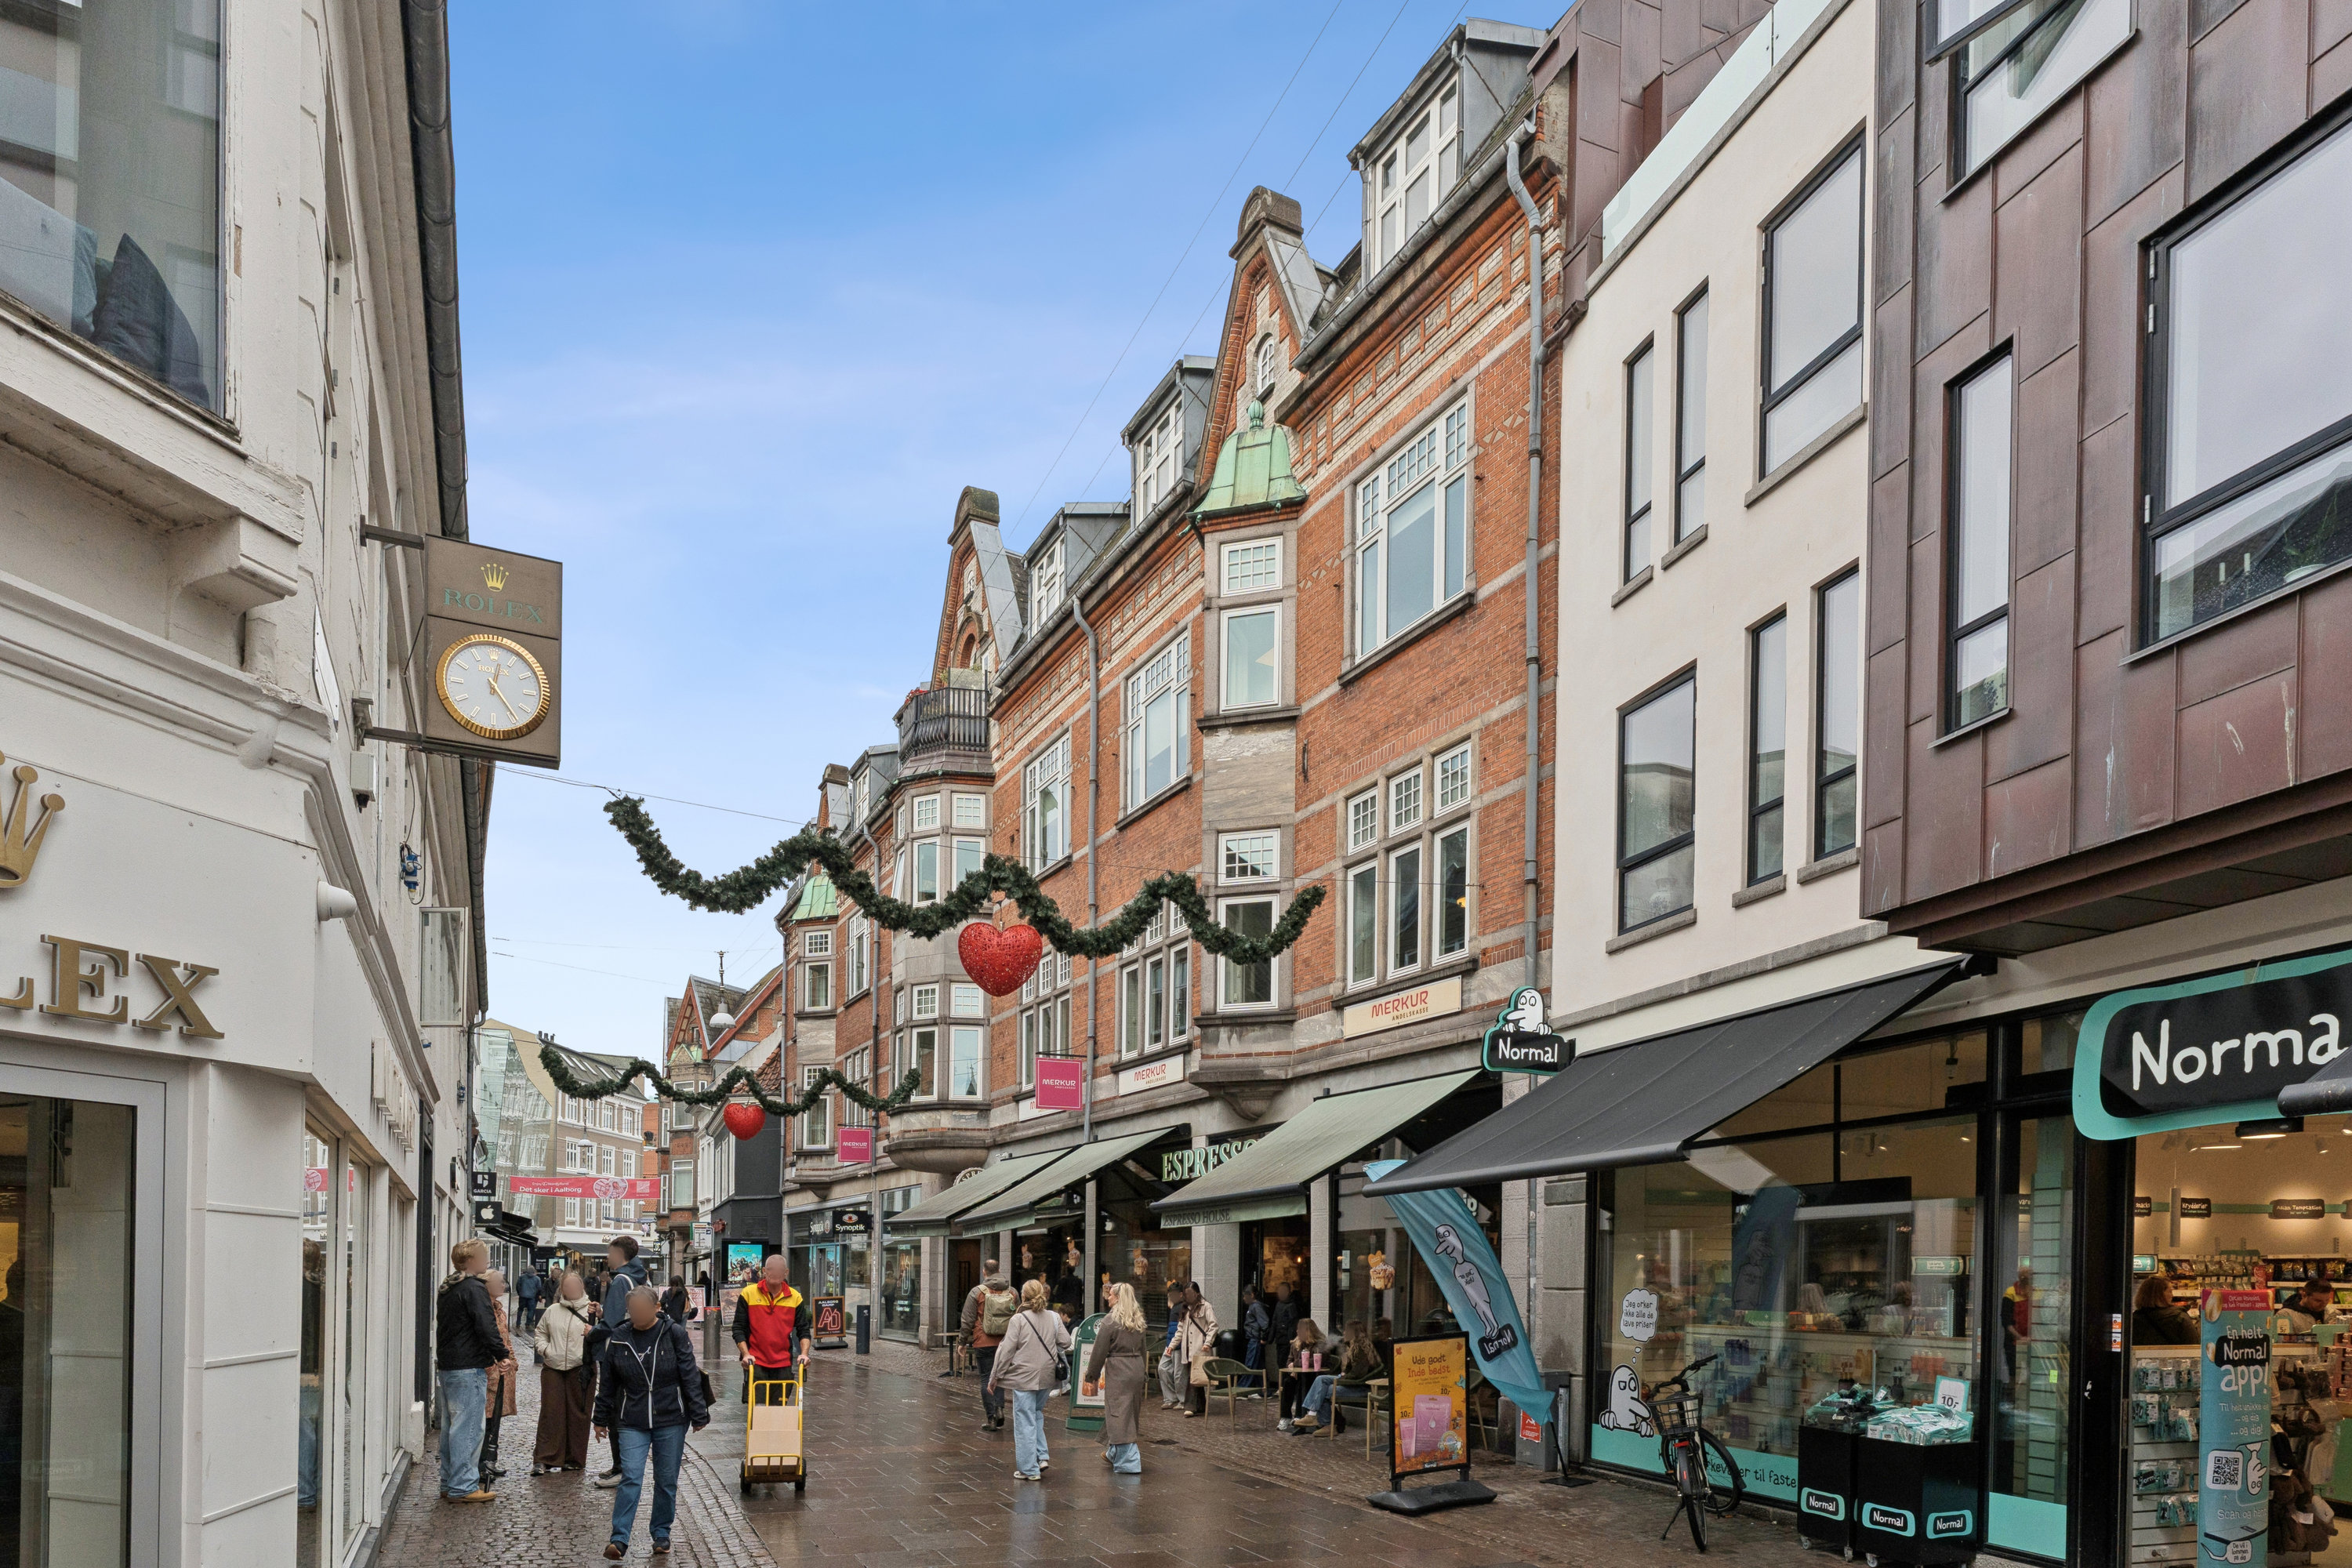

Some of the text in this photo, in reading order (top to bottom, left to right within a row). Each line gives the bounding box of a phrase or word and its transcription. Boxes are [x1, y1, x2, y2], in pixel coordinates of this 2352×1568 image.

[444, 589, 543, 623] ROLEX
[1371, 990, 1428, 1018] MERKUR
[1392, 1007, 1428, 1022] ANDELSKASSE
[1498, 1036, 1558, 1063] Normal
[1134, 1063, 1167, 1082] MERKUR
[1163, 1208, 1230, 1226] ESPRESSO HOUSE
[1625, 1299, 1653, 1308] Jeg orker
[1624, 1308, 1635, 1317] ikke
[1623, 1319, 1654, 1329] lave priser!
[2227, 1324, 2263, 1340] En helt
[2223, 1341, 2267, 1360] Normal
[1412, 1353, 1446, 1365] Ude godt
[1407, 1364, 1451, 1377] Inde bedst
[2220, 1362, 2268, 1397] app!
[1941, 1396, 1960, 1409] 10,-
[2219, 1403, 2229, 1411] Til
[2244, 1402, 2262, 1410] unikke
[2250, 1412, 2259, 1421] dig
[1754, 1469, 1766, 1482] til
[1769, 1470, 1797, 1488] faste
[1809, 1495, 1835, 1512] Normal
[1873, 1511, 1904, 1527] Normal
[2218, 1508, 2241, 1519] Scan
[1936, 1517, 1963, 1530] Normal
